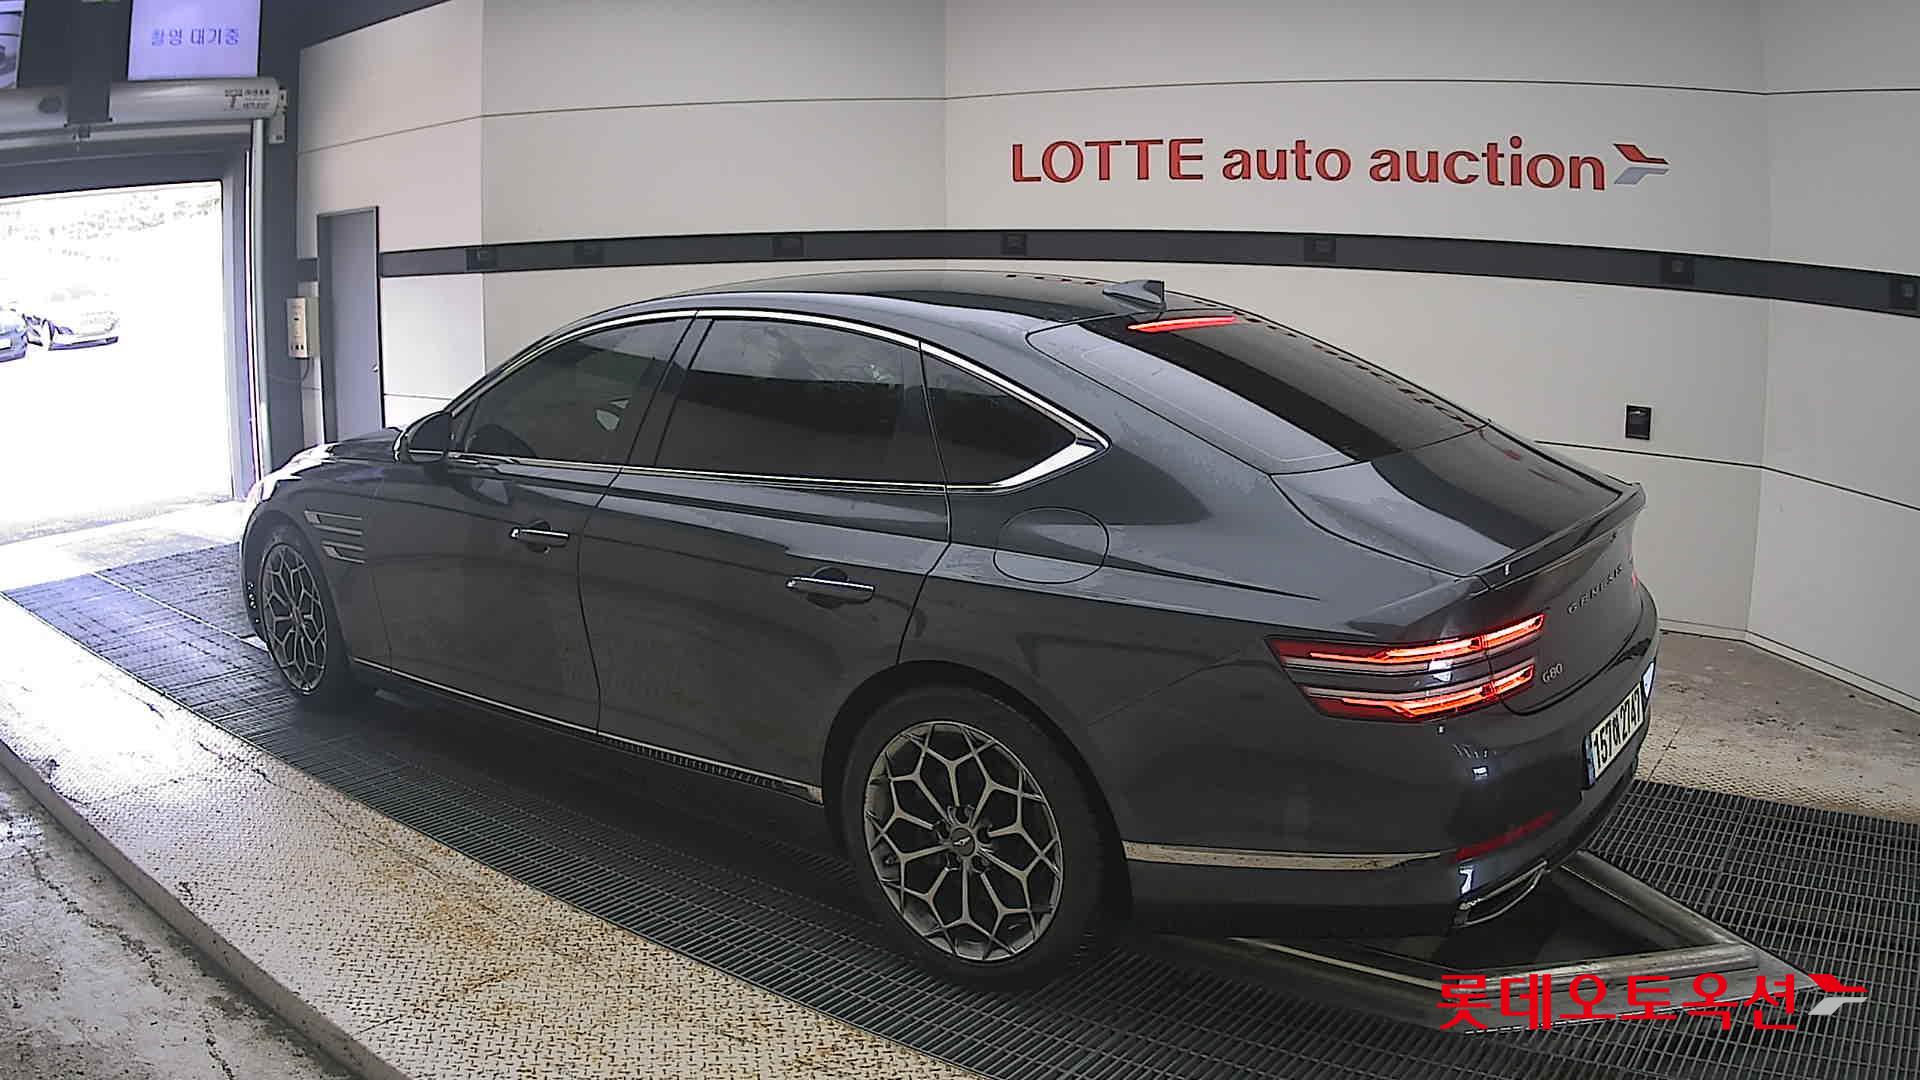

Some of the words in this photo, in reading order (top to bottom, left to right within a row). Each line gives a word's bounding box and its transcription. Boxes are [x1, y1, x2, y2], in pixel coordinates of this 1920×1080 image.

[191, 28, 239, 46] 대기중
[1011, 138, 1204, 183] LOTTE
[1222, 139, 1352, 182] auto
[1369, 135, 1606, 191] auction
[1542, 663, 1564, 684] G80
